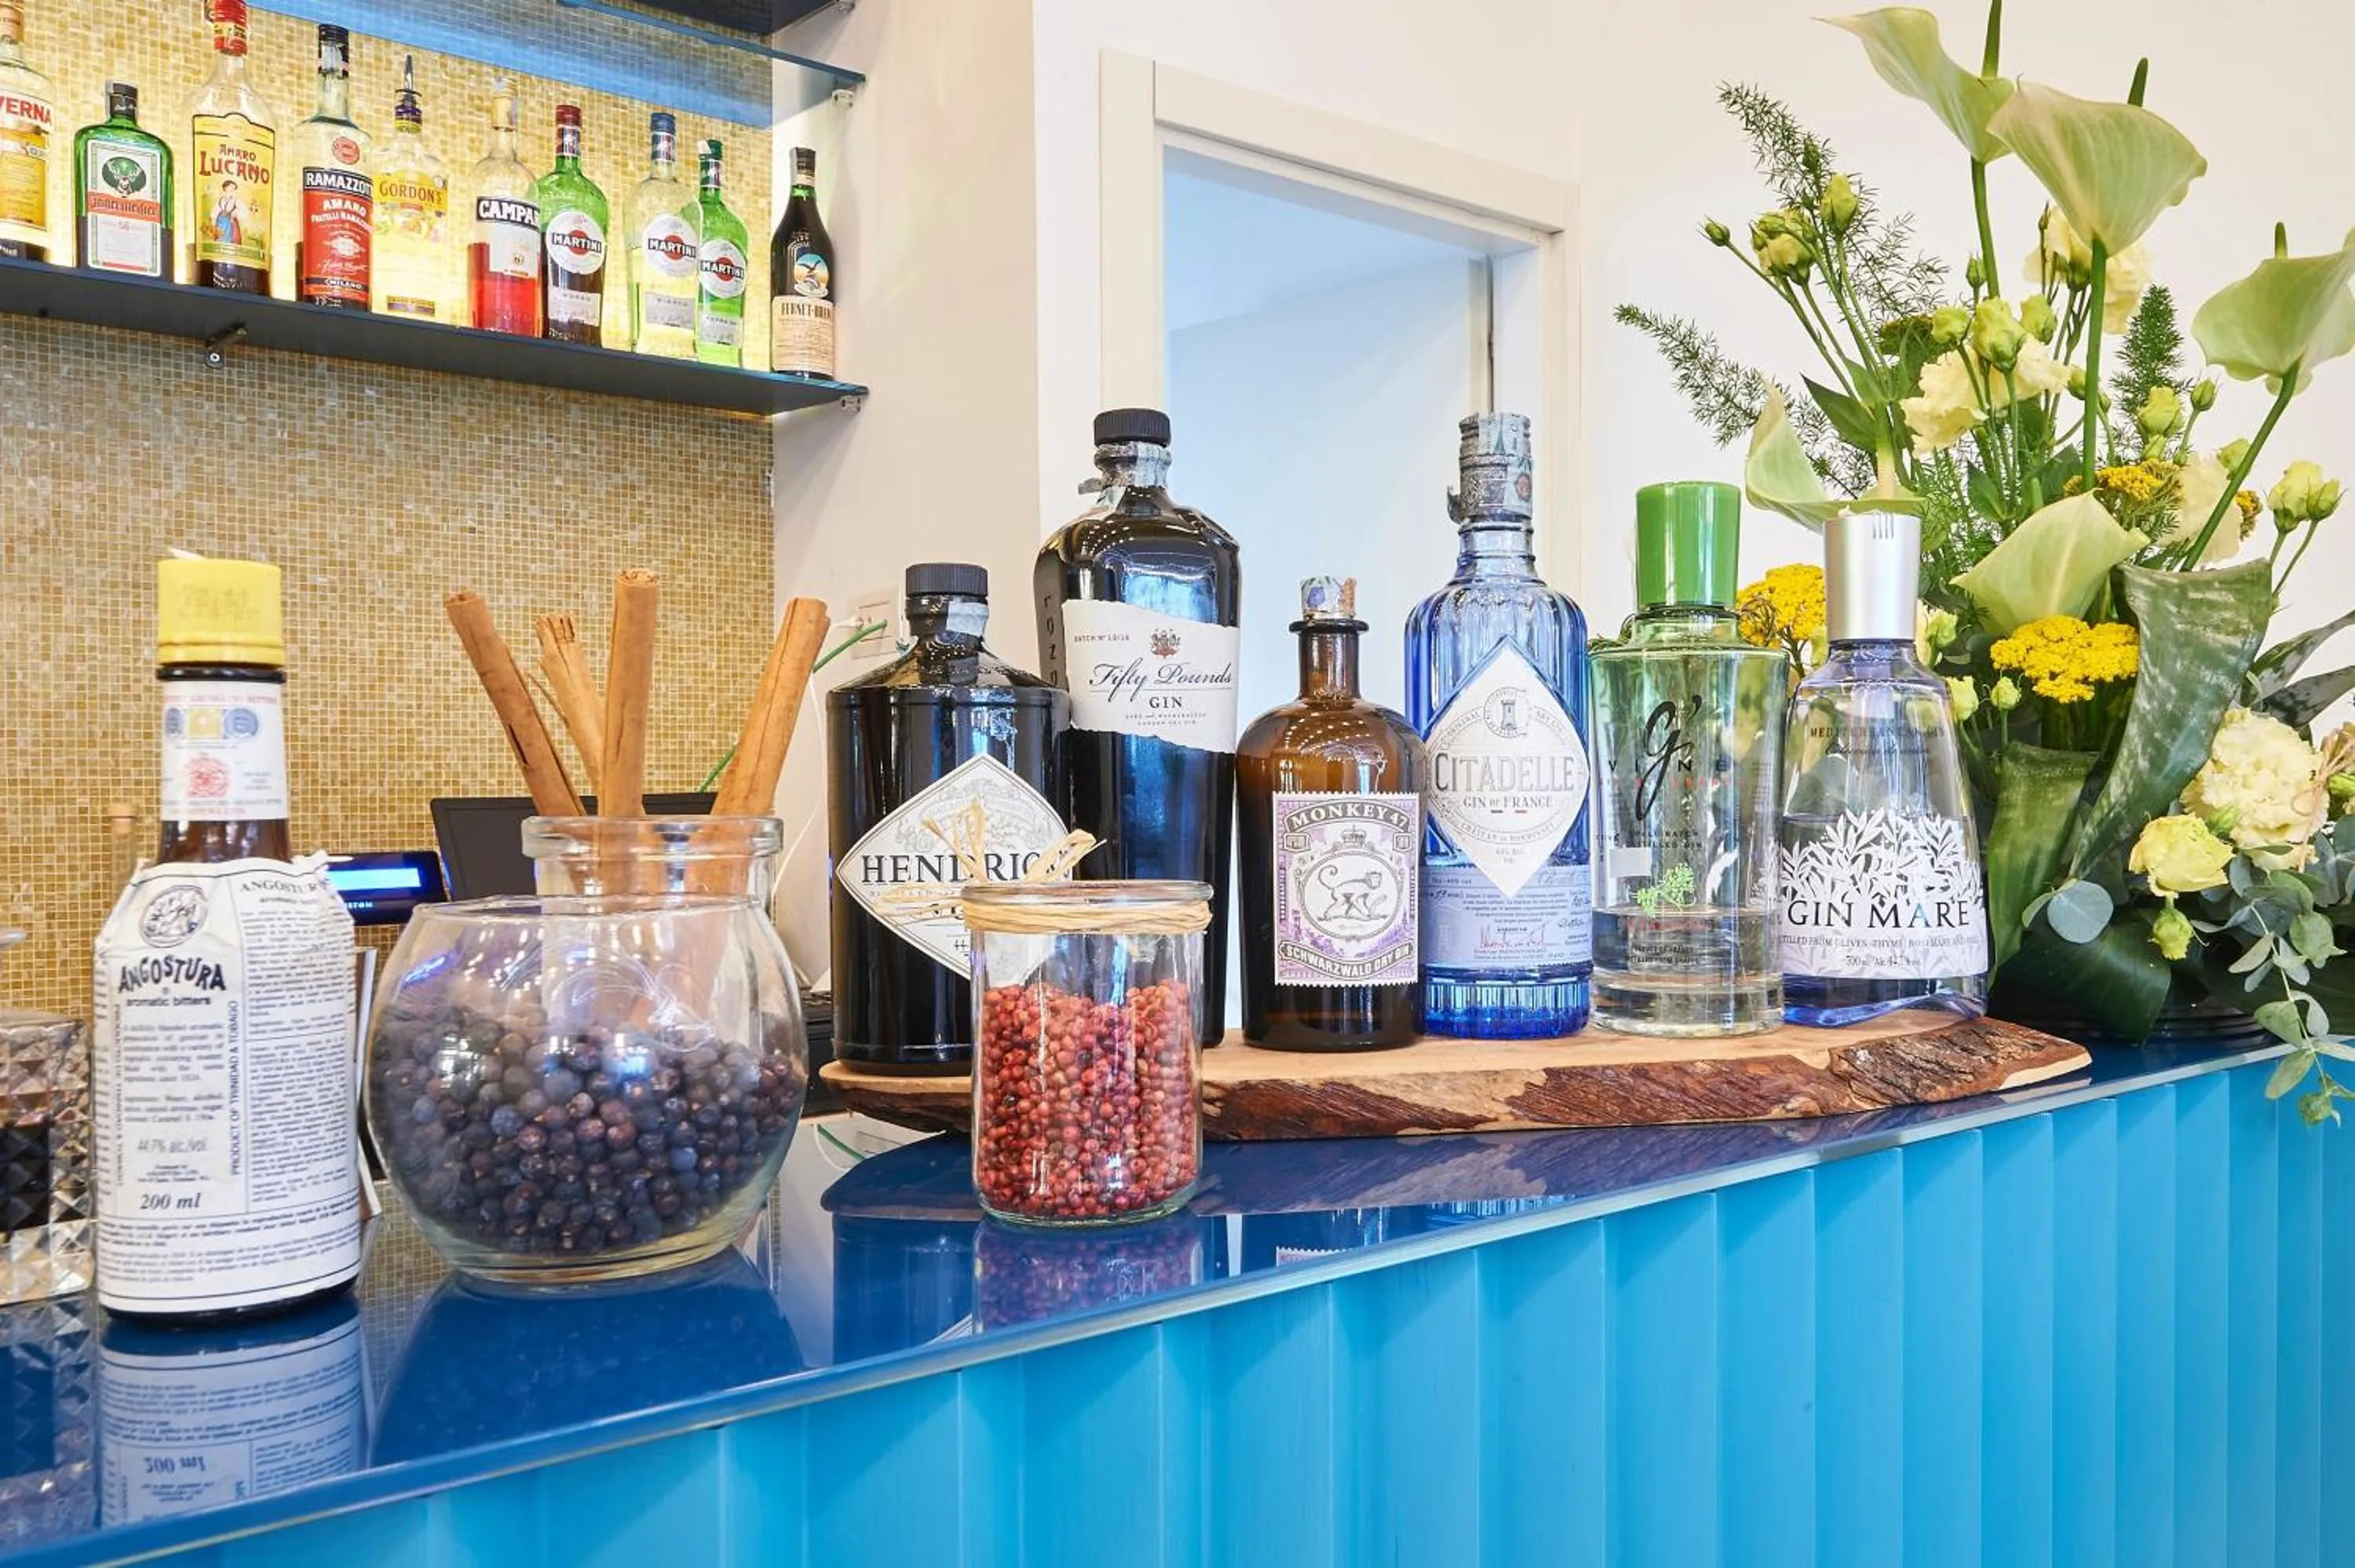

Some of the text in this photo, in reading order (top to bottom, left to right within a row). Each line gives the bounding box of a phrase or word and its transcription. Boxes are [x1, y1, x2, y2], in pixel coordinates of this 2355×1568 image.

[220, 144, 257, 162] AMARO
[199, 151, 270, 184] LUCANO
[380, 181, 442, 205] GORDON'S
[323, 199, 367, 216] AMARO
[553, 233, 602, 253] MARTINI
[648, 239, 696, 258] MARTINI
[701, 261, 744, 280] MARTINI
[1089, 657, 1232, 703] Fifty Pounds
[1148, 695, 1183, 709] GIN
[1435, 752, 1575, 793] CITADELLE
[1463, 796, 1486, 808] GIN
[1503, 796, 1555, 808] FRANCE
[1290, 803, 1408, 829] MONKEY 47
[1787, 900, 1970, 928] GIN MARE
[1286, 945, 1371, 977] SCHWARZWALD
[1374, 954, 1395, 971] DRY
[119, 954, 227, 994] ANGOSTURA
[126, 997, 211, 1007] aromatic bitters
[228, 1056, 239, 1104] TRINIDAD
[229, 1125, 240, 1175] PRODUCT
[140, 1192, 202, 1209] 200 ml
